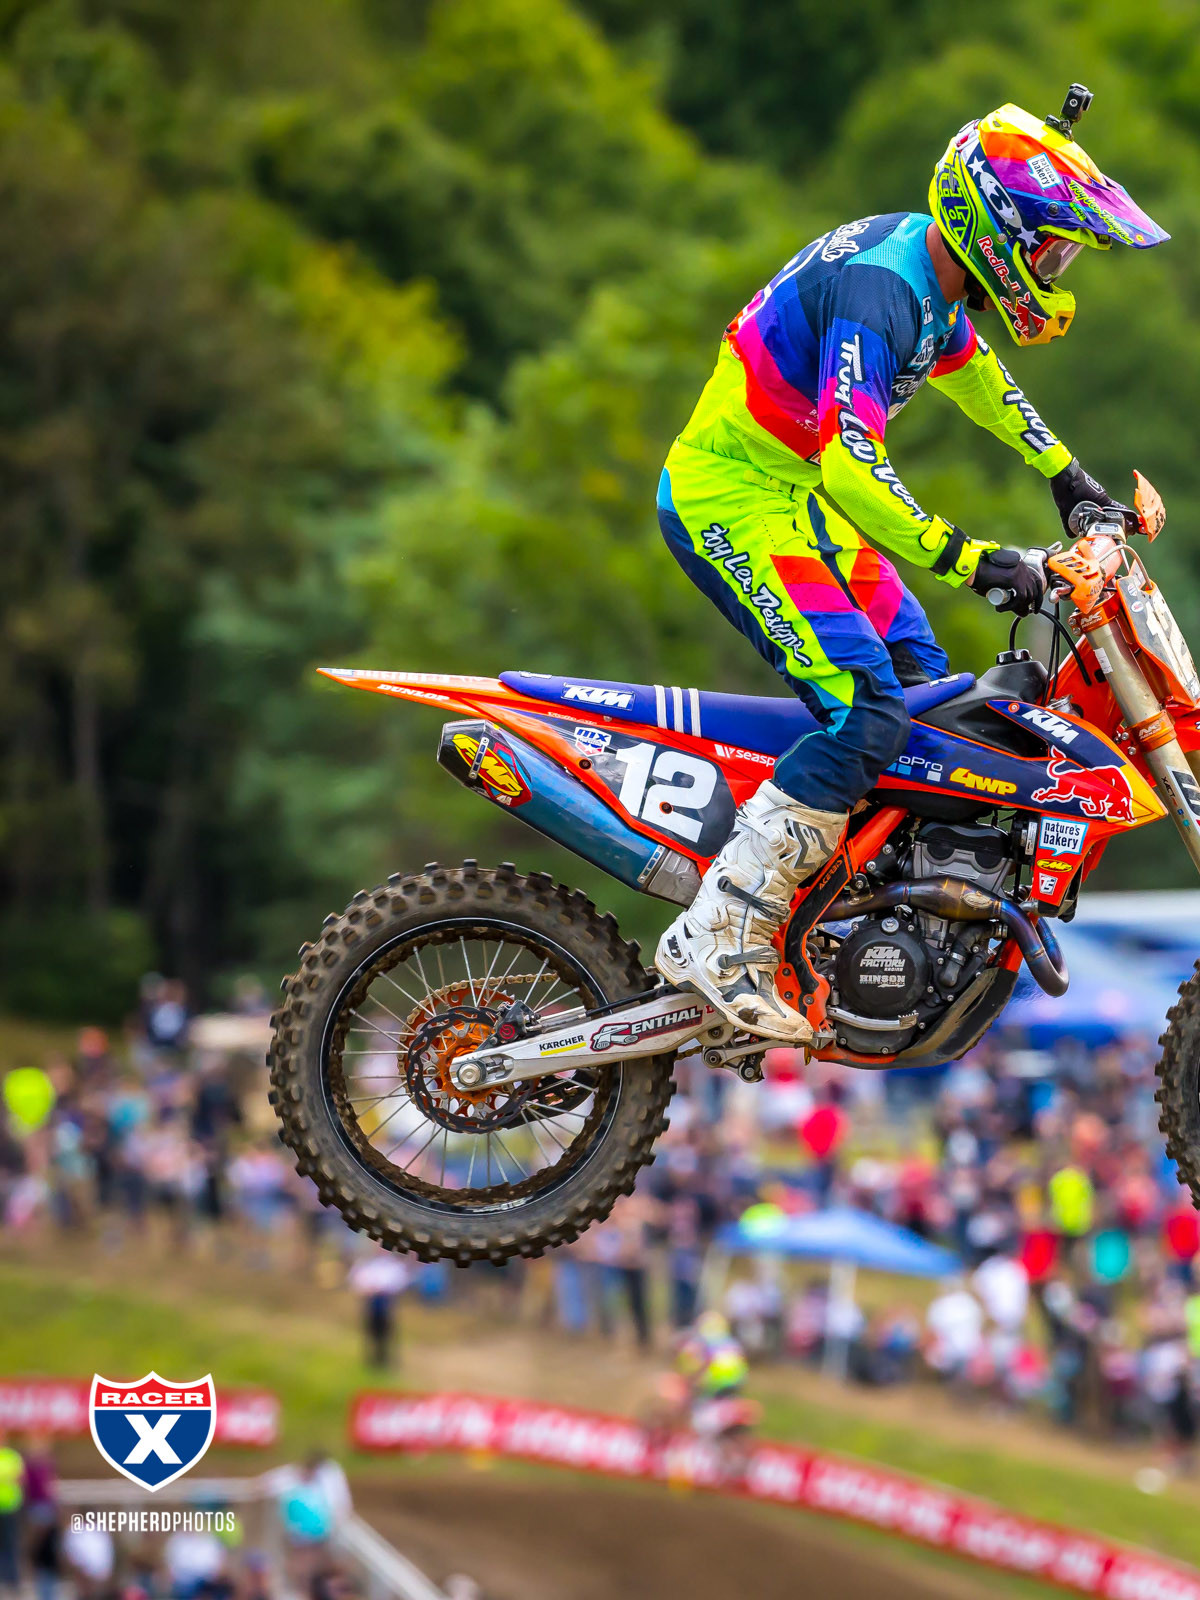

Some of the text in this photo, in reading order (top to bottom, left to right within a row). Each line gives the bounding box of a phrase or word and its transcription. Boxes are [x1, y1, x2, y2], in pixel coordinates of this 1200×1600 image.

[1031, 160, 1050, 185] bakery
[977, 235, 1004, 267] Red
[834, 332, 864, 408] Troy
[837, 407, 877, 464] Lee
[723, 552, 753, 594] Lee
[749, 582, 813, 667] Designs
[376, 683, 450, 701] DUNLOP
[563, 685, 632, 709] KTM
[1021, 709, 1080, 745] KTM
[735, 748, 776, 767] seasp
[897, 754, 943, 773] oPro
[615, 742, 717, 844] 12
[1161, 776, 1176, 798] XACT
[1045, 822, 1080, 836] nature's
[1043, 831, 1078, 849] bakery
[864, 946, 901, 959] KTM
[860, 958, 906, 968] FACTORY
[859, 974, 906, 983] HINSON
[539, 1034, 585, 1051] KÄRCHER
